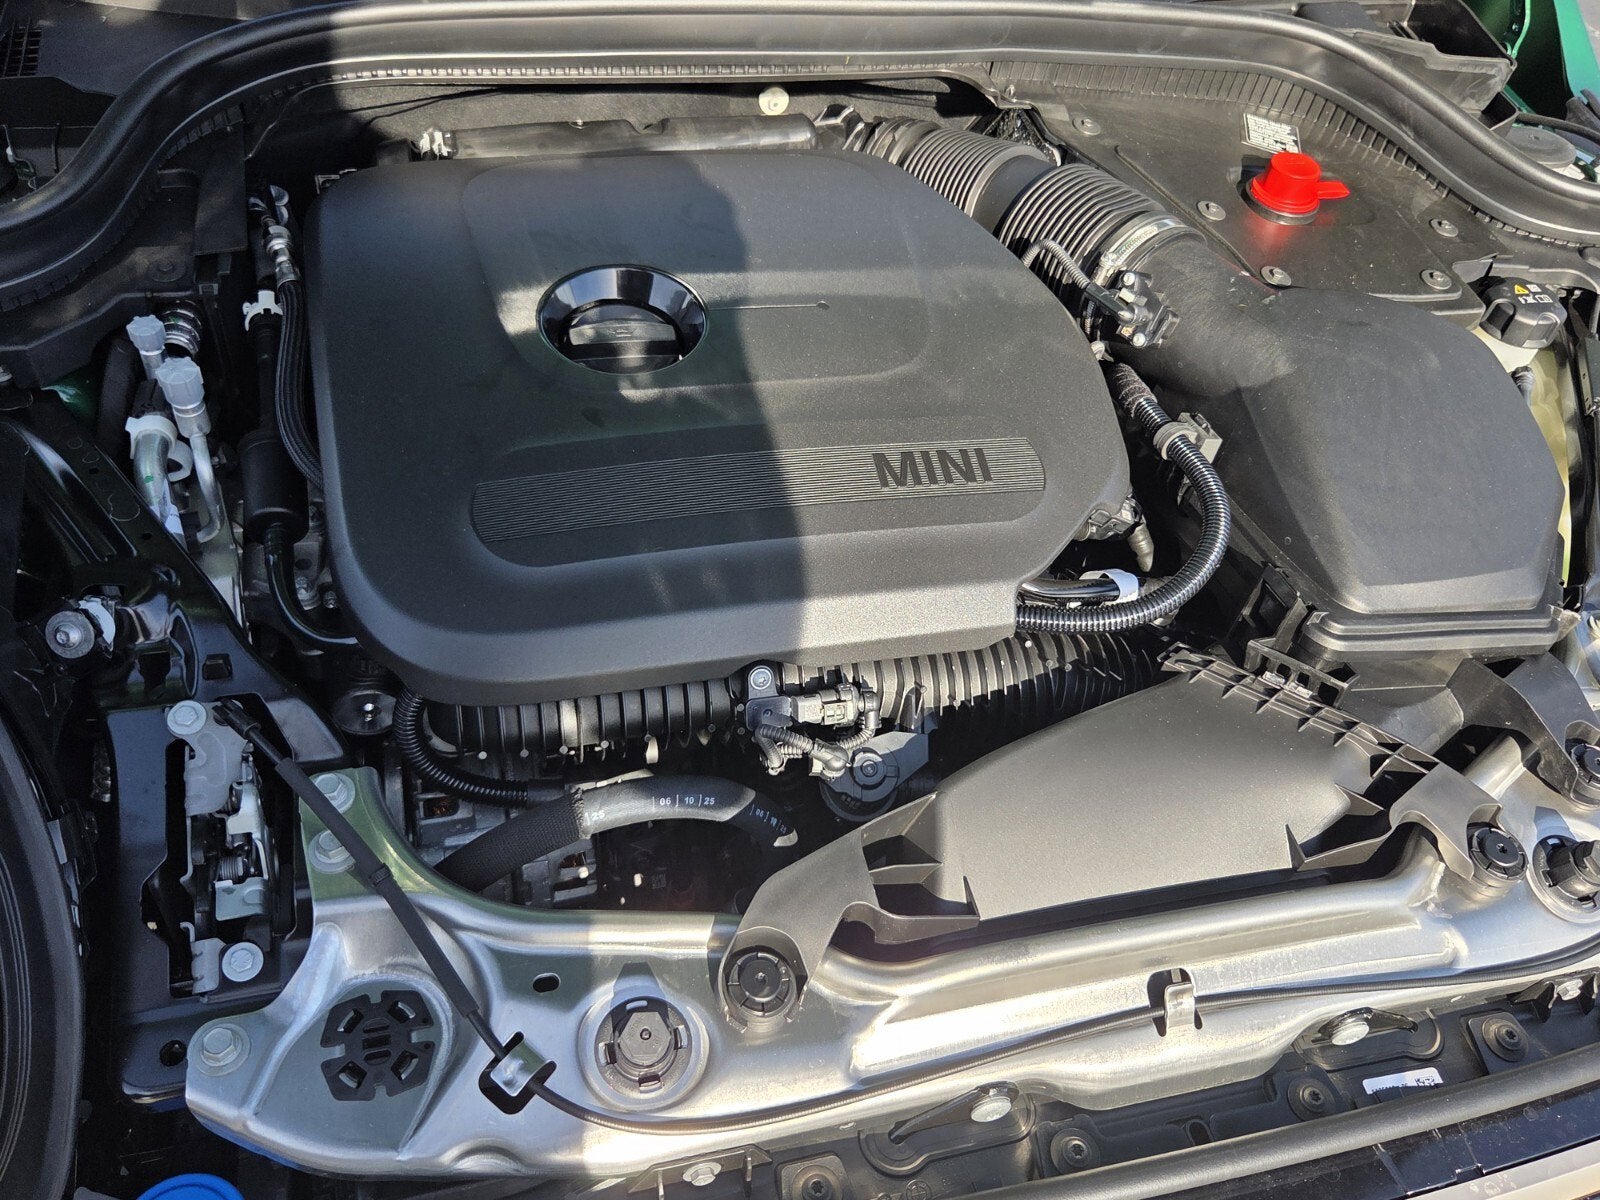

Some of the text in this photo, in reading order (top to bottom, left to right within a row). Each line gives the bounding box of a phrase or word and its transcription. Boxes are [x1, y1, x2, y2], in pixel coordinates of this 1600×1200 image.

[872, 448, 993, 488] MINI
[659, 796, 716, 806] 06 10 25
[755, 808, 764, 817] 06
